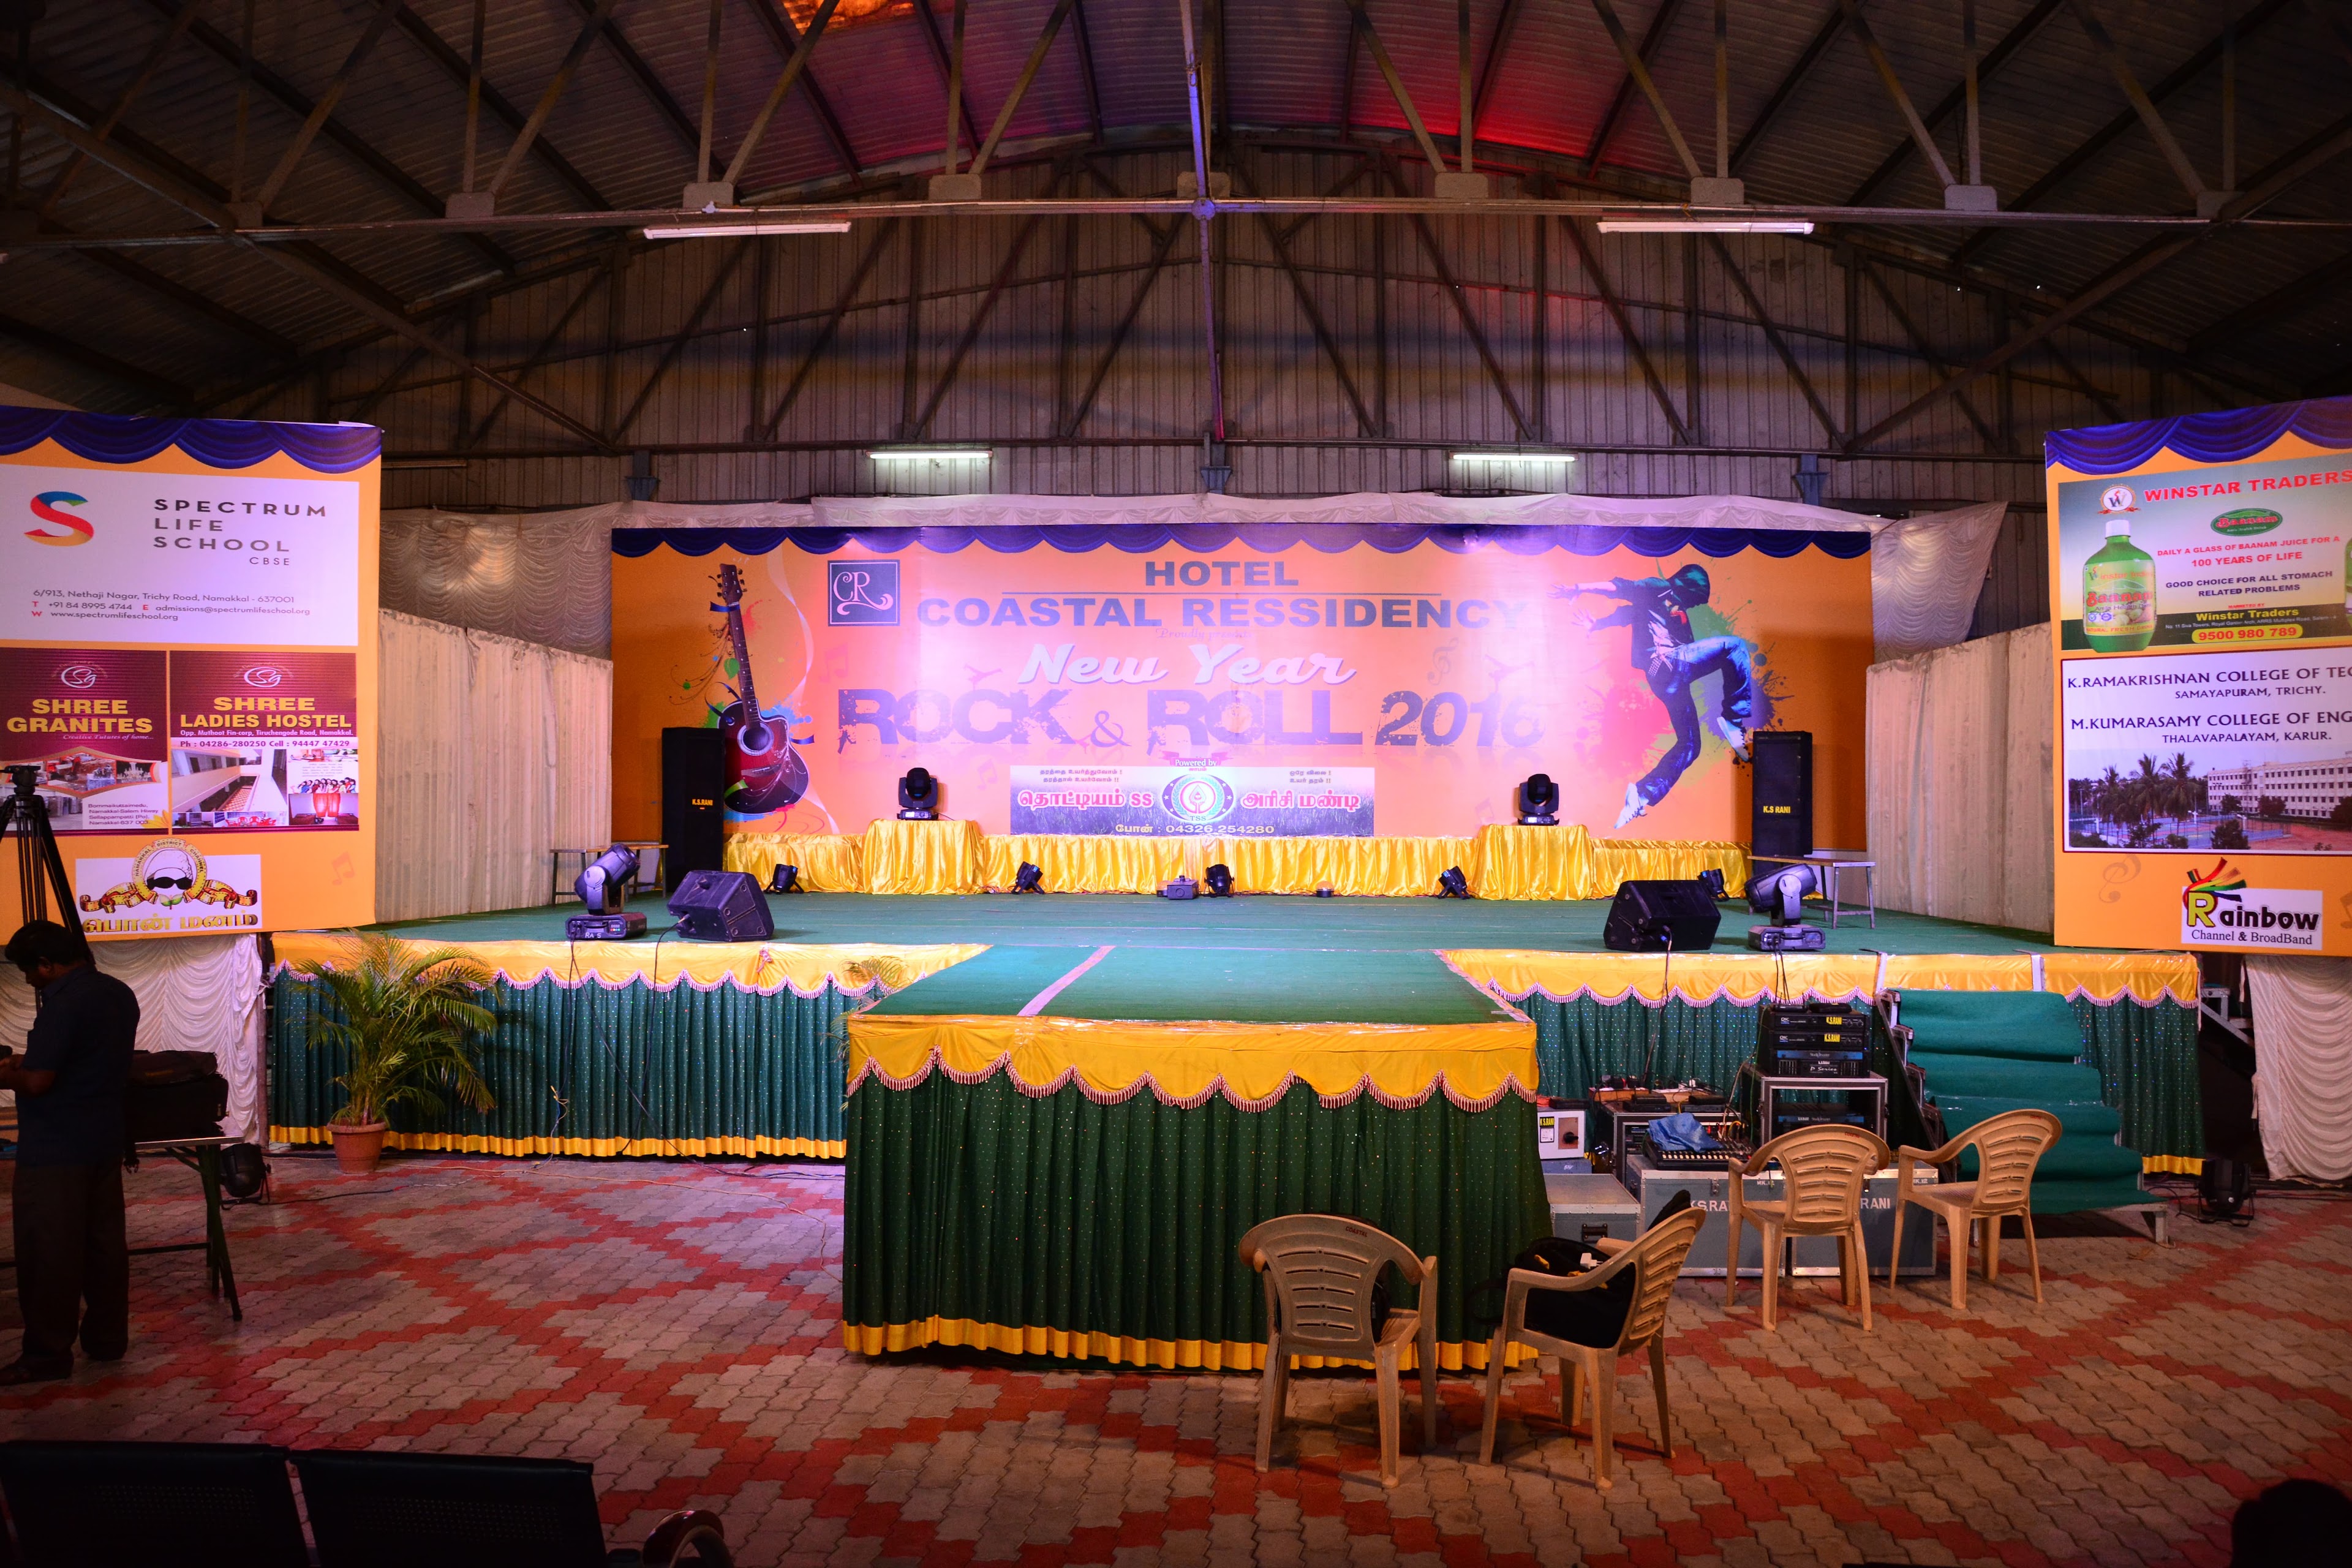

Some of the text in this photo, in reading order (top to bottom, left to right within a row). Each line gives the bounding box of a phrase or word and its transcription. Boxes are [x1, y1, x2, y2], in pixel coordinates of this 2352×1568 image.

[2144, 469, 2352, 502] WINSTAR TRADERS
[154, 499, 326, 517] SPECTRUM
[154, 518, 223, 532] LIFE
[153, 537, 290, 552] SCHOOL
[2239, 541, 2277, 550] BAANAM
[2280, 538, 2308, 547] JUICE
[249, 556, 290, 566] CBSE
[2215, 556, 2253, 565] YEARS
[2256, 554, 2272, 562] OF
[2276, 551, 2303, 561] LIFE
[1145, 560, 1299, 587] HOTEL
[2196, 578, 2234, 586] CHOICE
[2281, 570, 2333, 581] STOMACH
[67, 591, 104, 600] Nethaji
[142, 593, 170, 601] Trichy
[2199, 584, 2301, 597] RELATED PROBLEMS
[50, 612, 179, 621] www.spectrumlifeschool.org
[156, 605, 311, 616] admissions@spectrumlifeschool.org
[917, 597, 1529, 629] COASTAL RESSIDENCY
[2196, 608, 2300, 621] Winstar Traders
[2198, 626, 2297, 641] 9500 980 789
[1017, 643, 1357, 686] New Year
[2067, 673, 2210, 688] K.RAMAKRISHNAN
[2216, 669, 2290, 683] COLLEGE
[2296, 667, 2320, 679] OF
[2174, 685, 2326, 699] SAMAYAPURAM, TRICHY.
[32, 698, 128, 714] SHREE
[213, 696, 315, 711] SHREE
[7, 717, 153, 733] GRANITES
[180, 714, 352, 728] LADIES HOSTEL
[837, 688, 1547, 748] ROCK & ROLL 2016
[2071, 715, 2201, 730] M.KUMARASAMY
[2206, 713, 2280, 726] COLLEGE
[2286, 712, 2310, 724] OF
[2162, 731, 2332, 744] THALAVAPALAYAM, KARUR.
[1019, 788, 1153, 809] தொட்டியம் SS
[1242, 789, 1360, 812] அரிசி மண்டி
[1115, 823, 1153, 833] போன்
[189, 848, 205, 873] CHANNEL
[2187, 891, 2320, 931] Rainbow
[179, 910, 258, 929] மனம்
[2192, 929, 2313, 945] Channel & BroadBand
